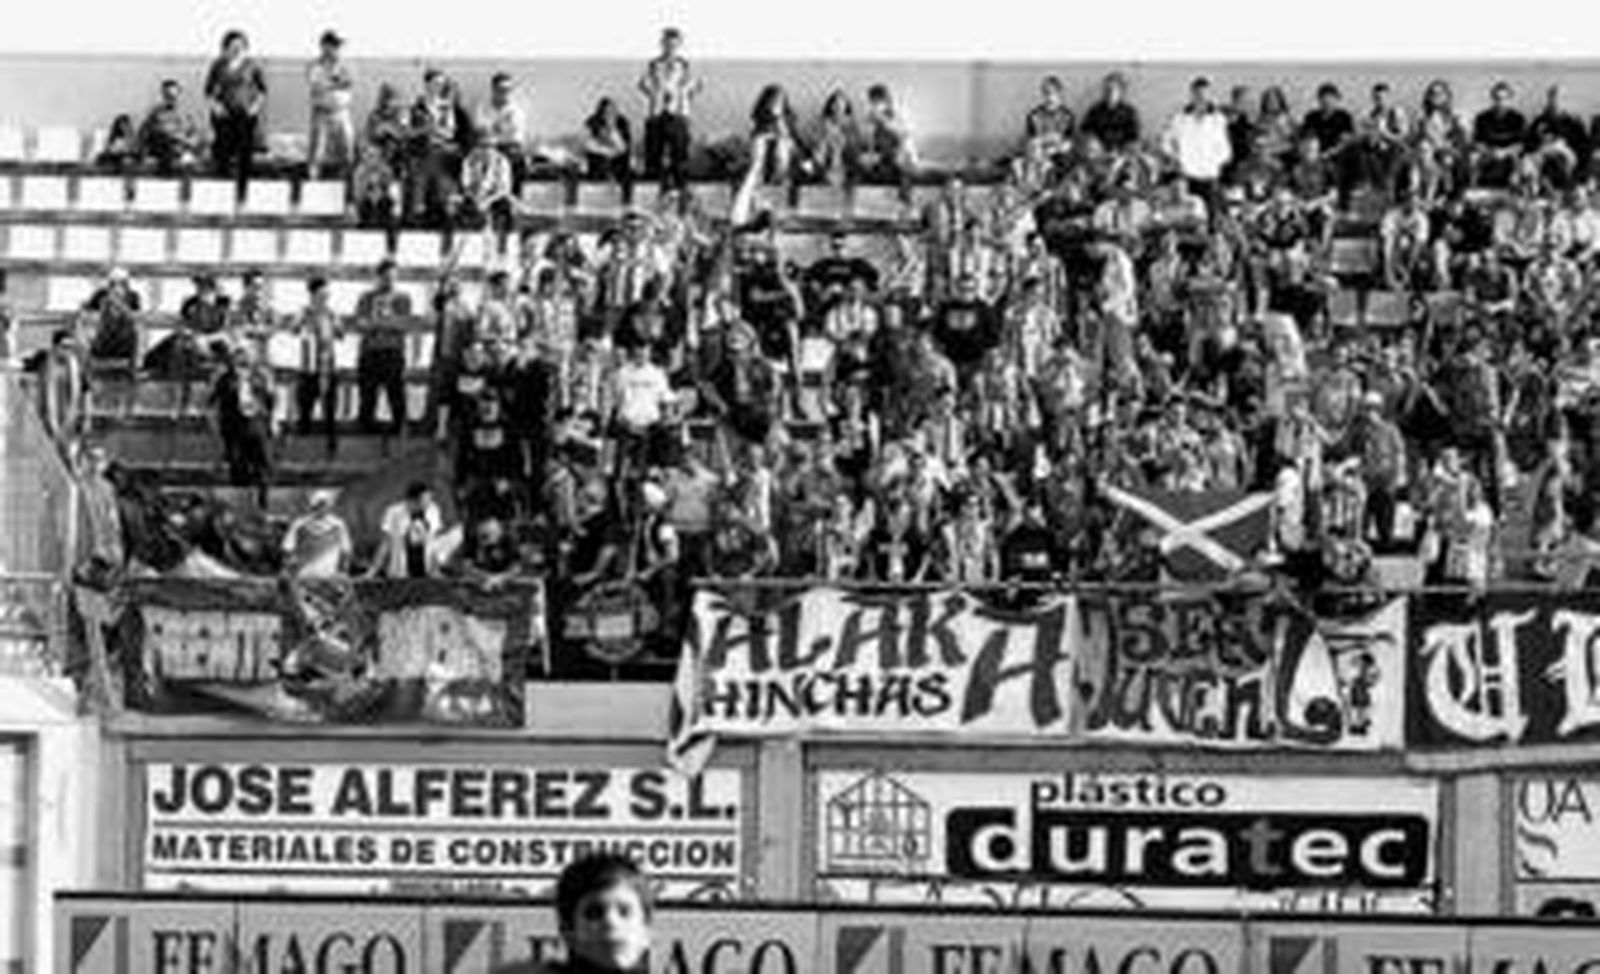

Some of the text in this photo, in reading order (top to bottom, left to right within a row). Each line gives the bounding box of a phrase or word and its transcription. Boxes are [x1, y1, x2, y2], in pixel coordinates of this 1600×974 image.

[704, 672, 952, 719] HINCHAS
[152, 766, 737, 820] JOSE ALFEREZ S.L.
[152, 834, 378, 864] MATERIALES
[390, 839, 436, 864] DE
[970, 796, 1408, 877] duratec
